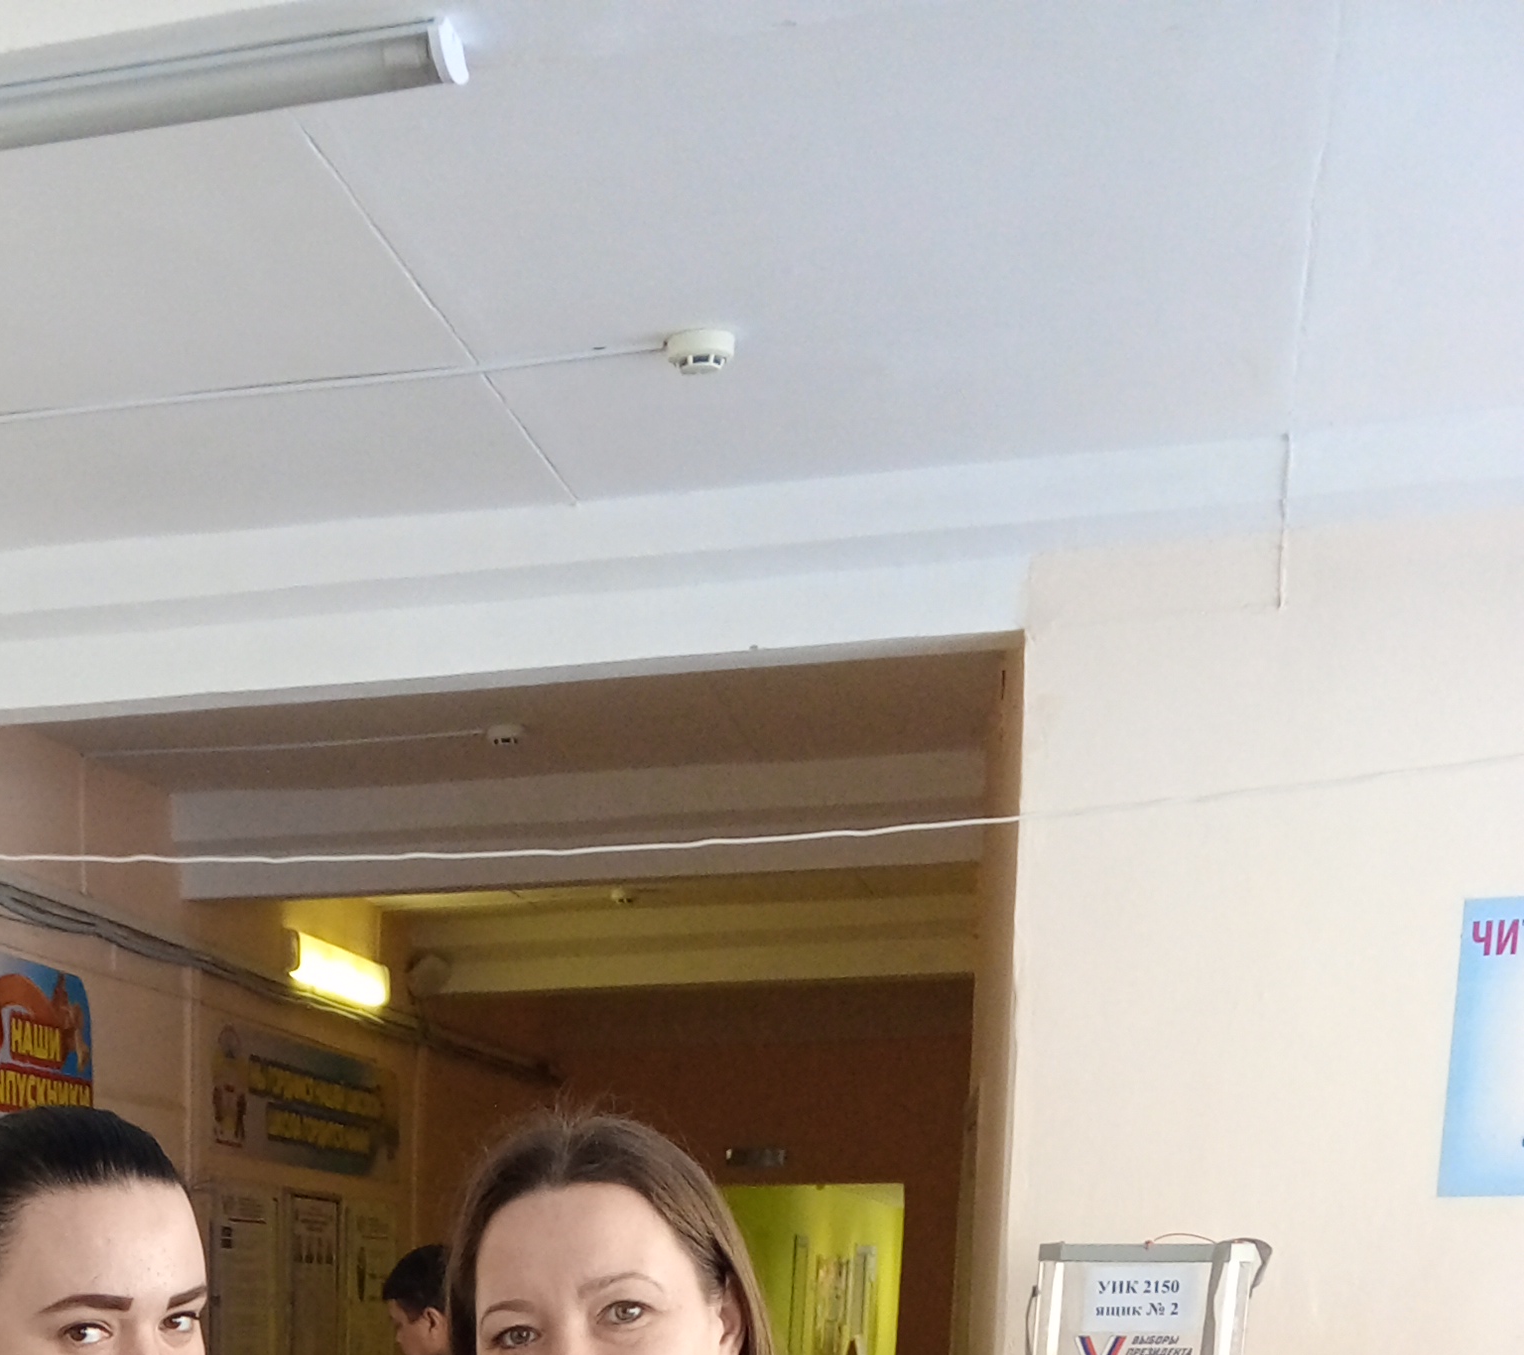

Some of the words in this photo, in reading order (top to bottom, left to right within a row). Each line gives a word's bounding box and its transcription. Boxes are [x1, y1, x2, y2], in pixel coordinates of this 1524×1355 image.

[1472, 918, 1524, 956] ЧИ
[11, 1017, 62, 1063] НАШИ
[1097, 1280, 1139, 1294] УИК
[1143, 1279, 1180, 1294] 2150
[1095, 1305, 1143, 1317] ящик
[1146, 1302, 1166, 1316] №
[1170, 1302, 1179, 1316] 2
[1131, 1335, 1179, 1345] ВЫБОРЫ
